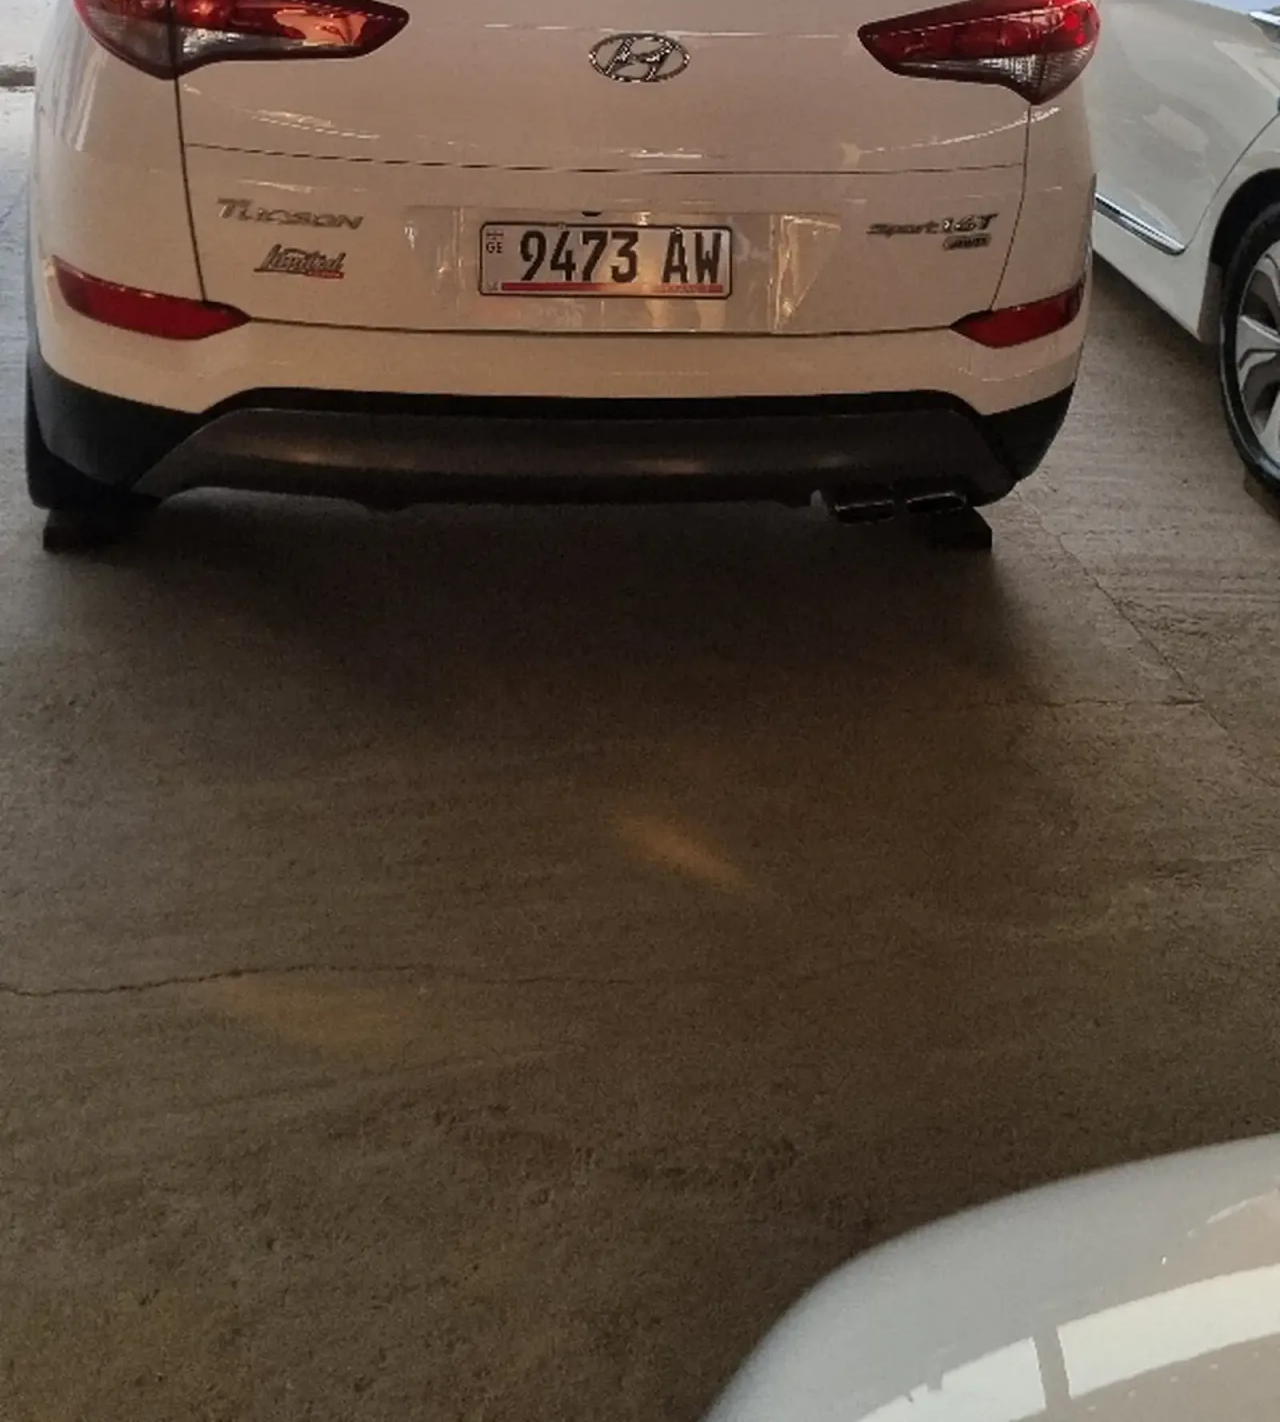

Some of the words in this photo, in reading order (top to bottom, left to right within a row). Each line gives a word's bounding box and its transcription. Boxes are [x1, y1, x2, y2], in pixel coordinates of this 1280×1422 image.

[216, 197, 364, 230] TUCSON
[520, 230, 639, 284] 9473
[662, 230, 722, 284] AW
